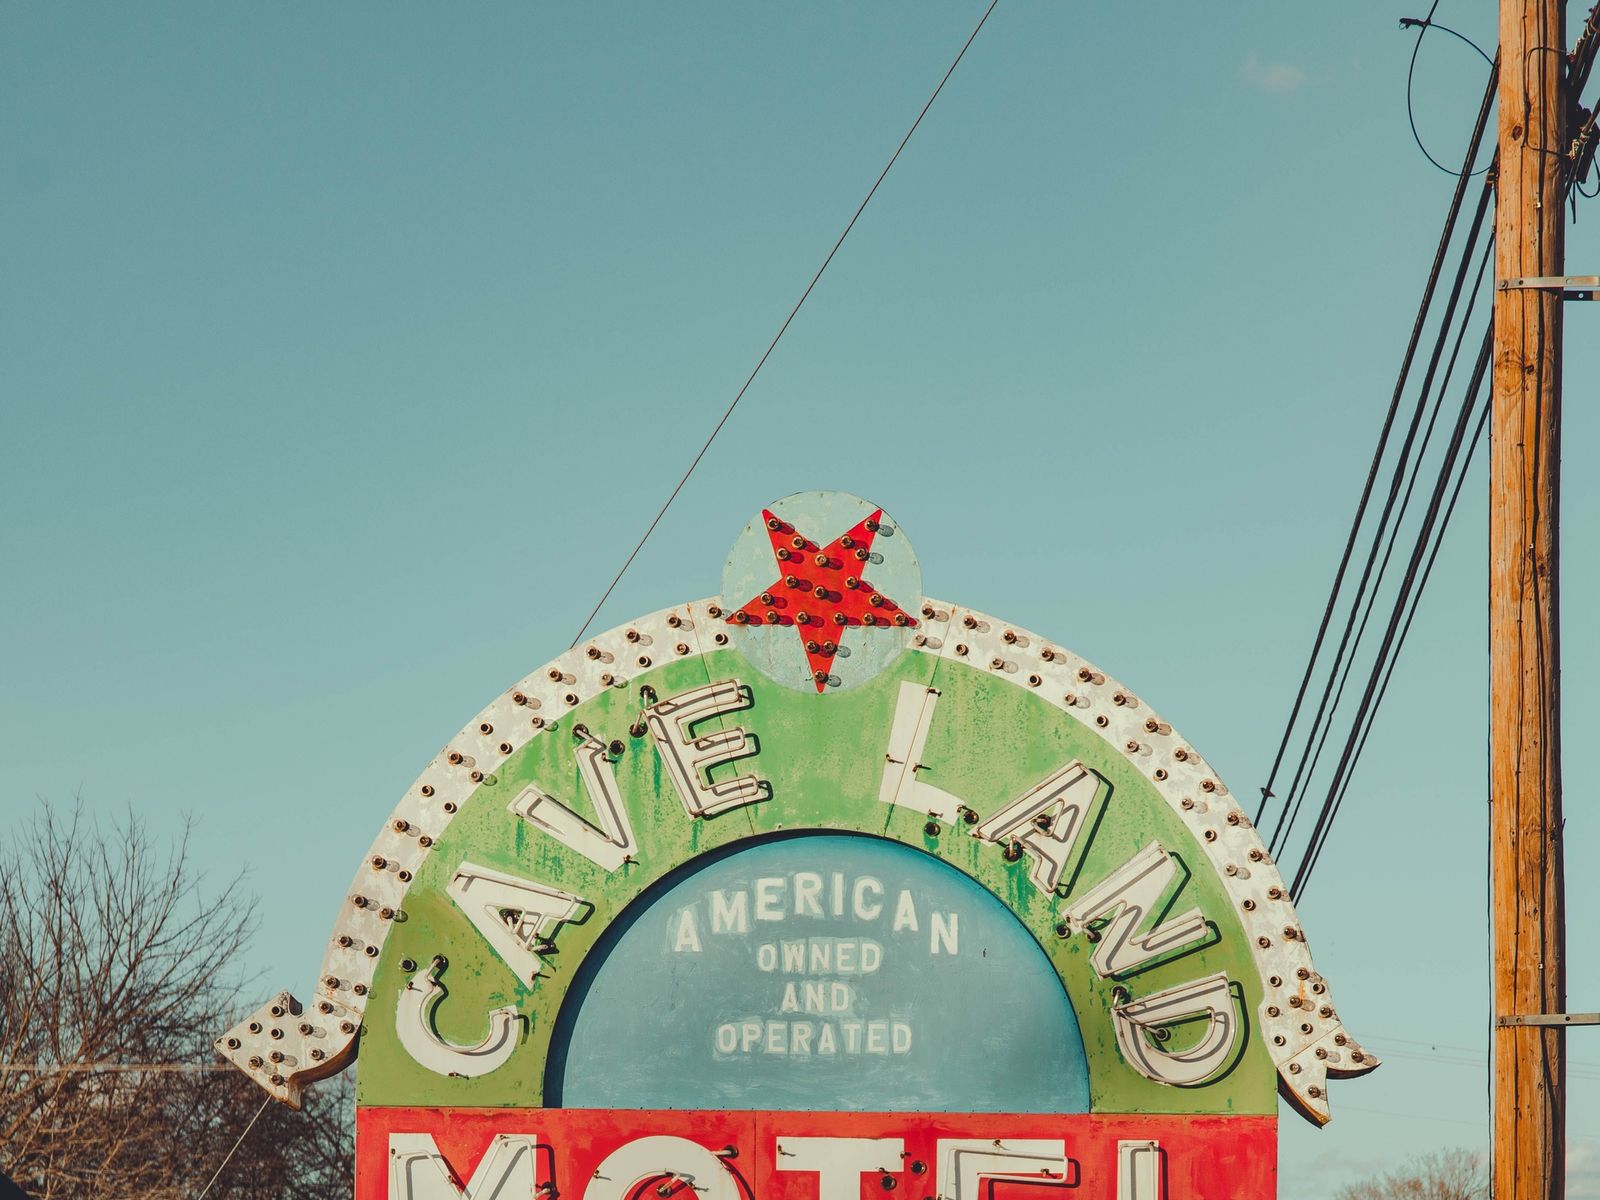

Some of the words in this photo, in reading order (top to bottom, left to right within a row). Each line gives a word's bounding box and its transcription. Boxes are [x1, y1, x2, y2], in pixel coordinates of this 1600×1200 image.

[674, 872, 959, 955] AMERICAN
[757, 943, 881, 972] OWNED
[782, 982, 850, 1013] AND
[717, 1022, 912, 1055] OPERATED
